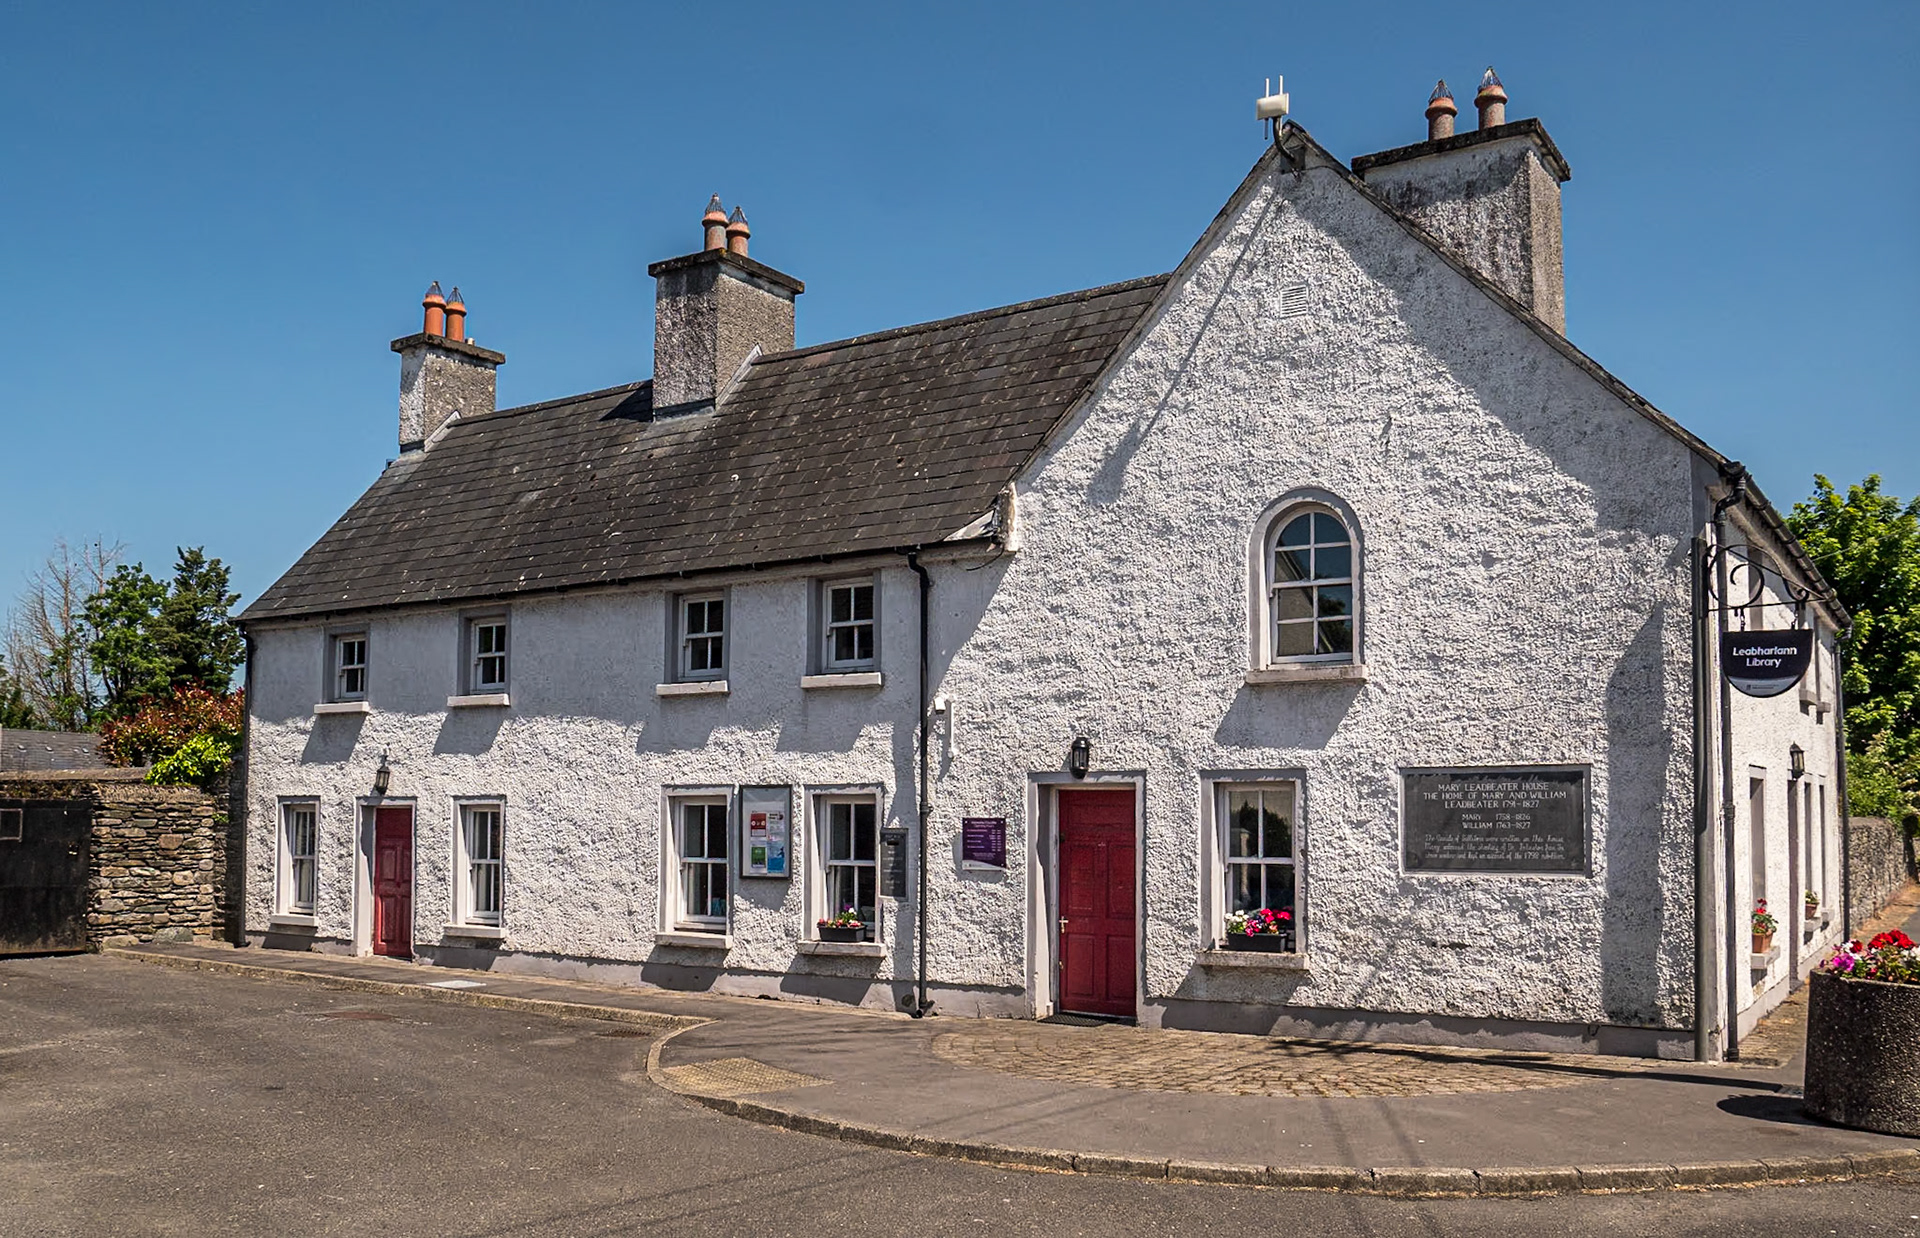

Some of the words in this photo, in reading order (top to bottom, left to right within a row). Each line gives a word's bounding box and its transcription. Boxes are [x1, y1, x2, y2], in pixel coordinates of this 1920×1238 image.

[1733, 646, 1798, 656] Leabharlann
[1746, 658, 1782, 668] Library
[1438, 783, 1460, 792] MARY
[1464, 783, 1519, 792] LEADBEATER
[1522, 783, 1549, 791] HOUSE
[1423, 792, 1439, 800] THE
[1441, 792, 1464, 800] HOME
[1468, 792, 1478, 800] OF
[1482, 791, 1504, 800] MARY
[1509, 791, 1527, 800] AND
[1529, 791, 1567, 799] WILLIAM
[1445, 800, 1499, 809] LEADBEATER
[1462, 813, 1481, 821] MARY
[1462, 821, 1493, 829] WILLIAM
